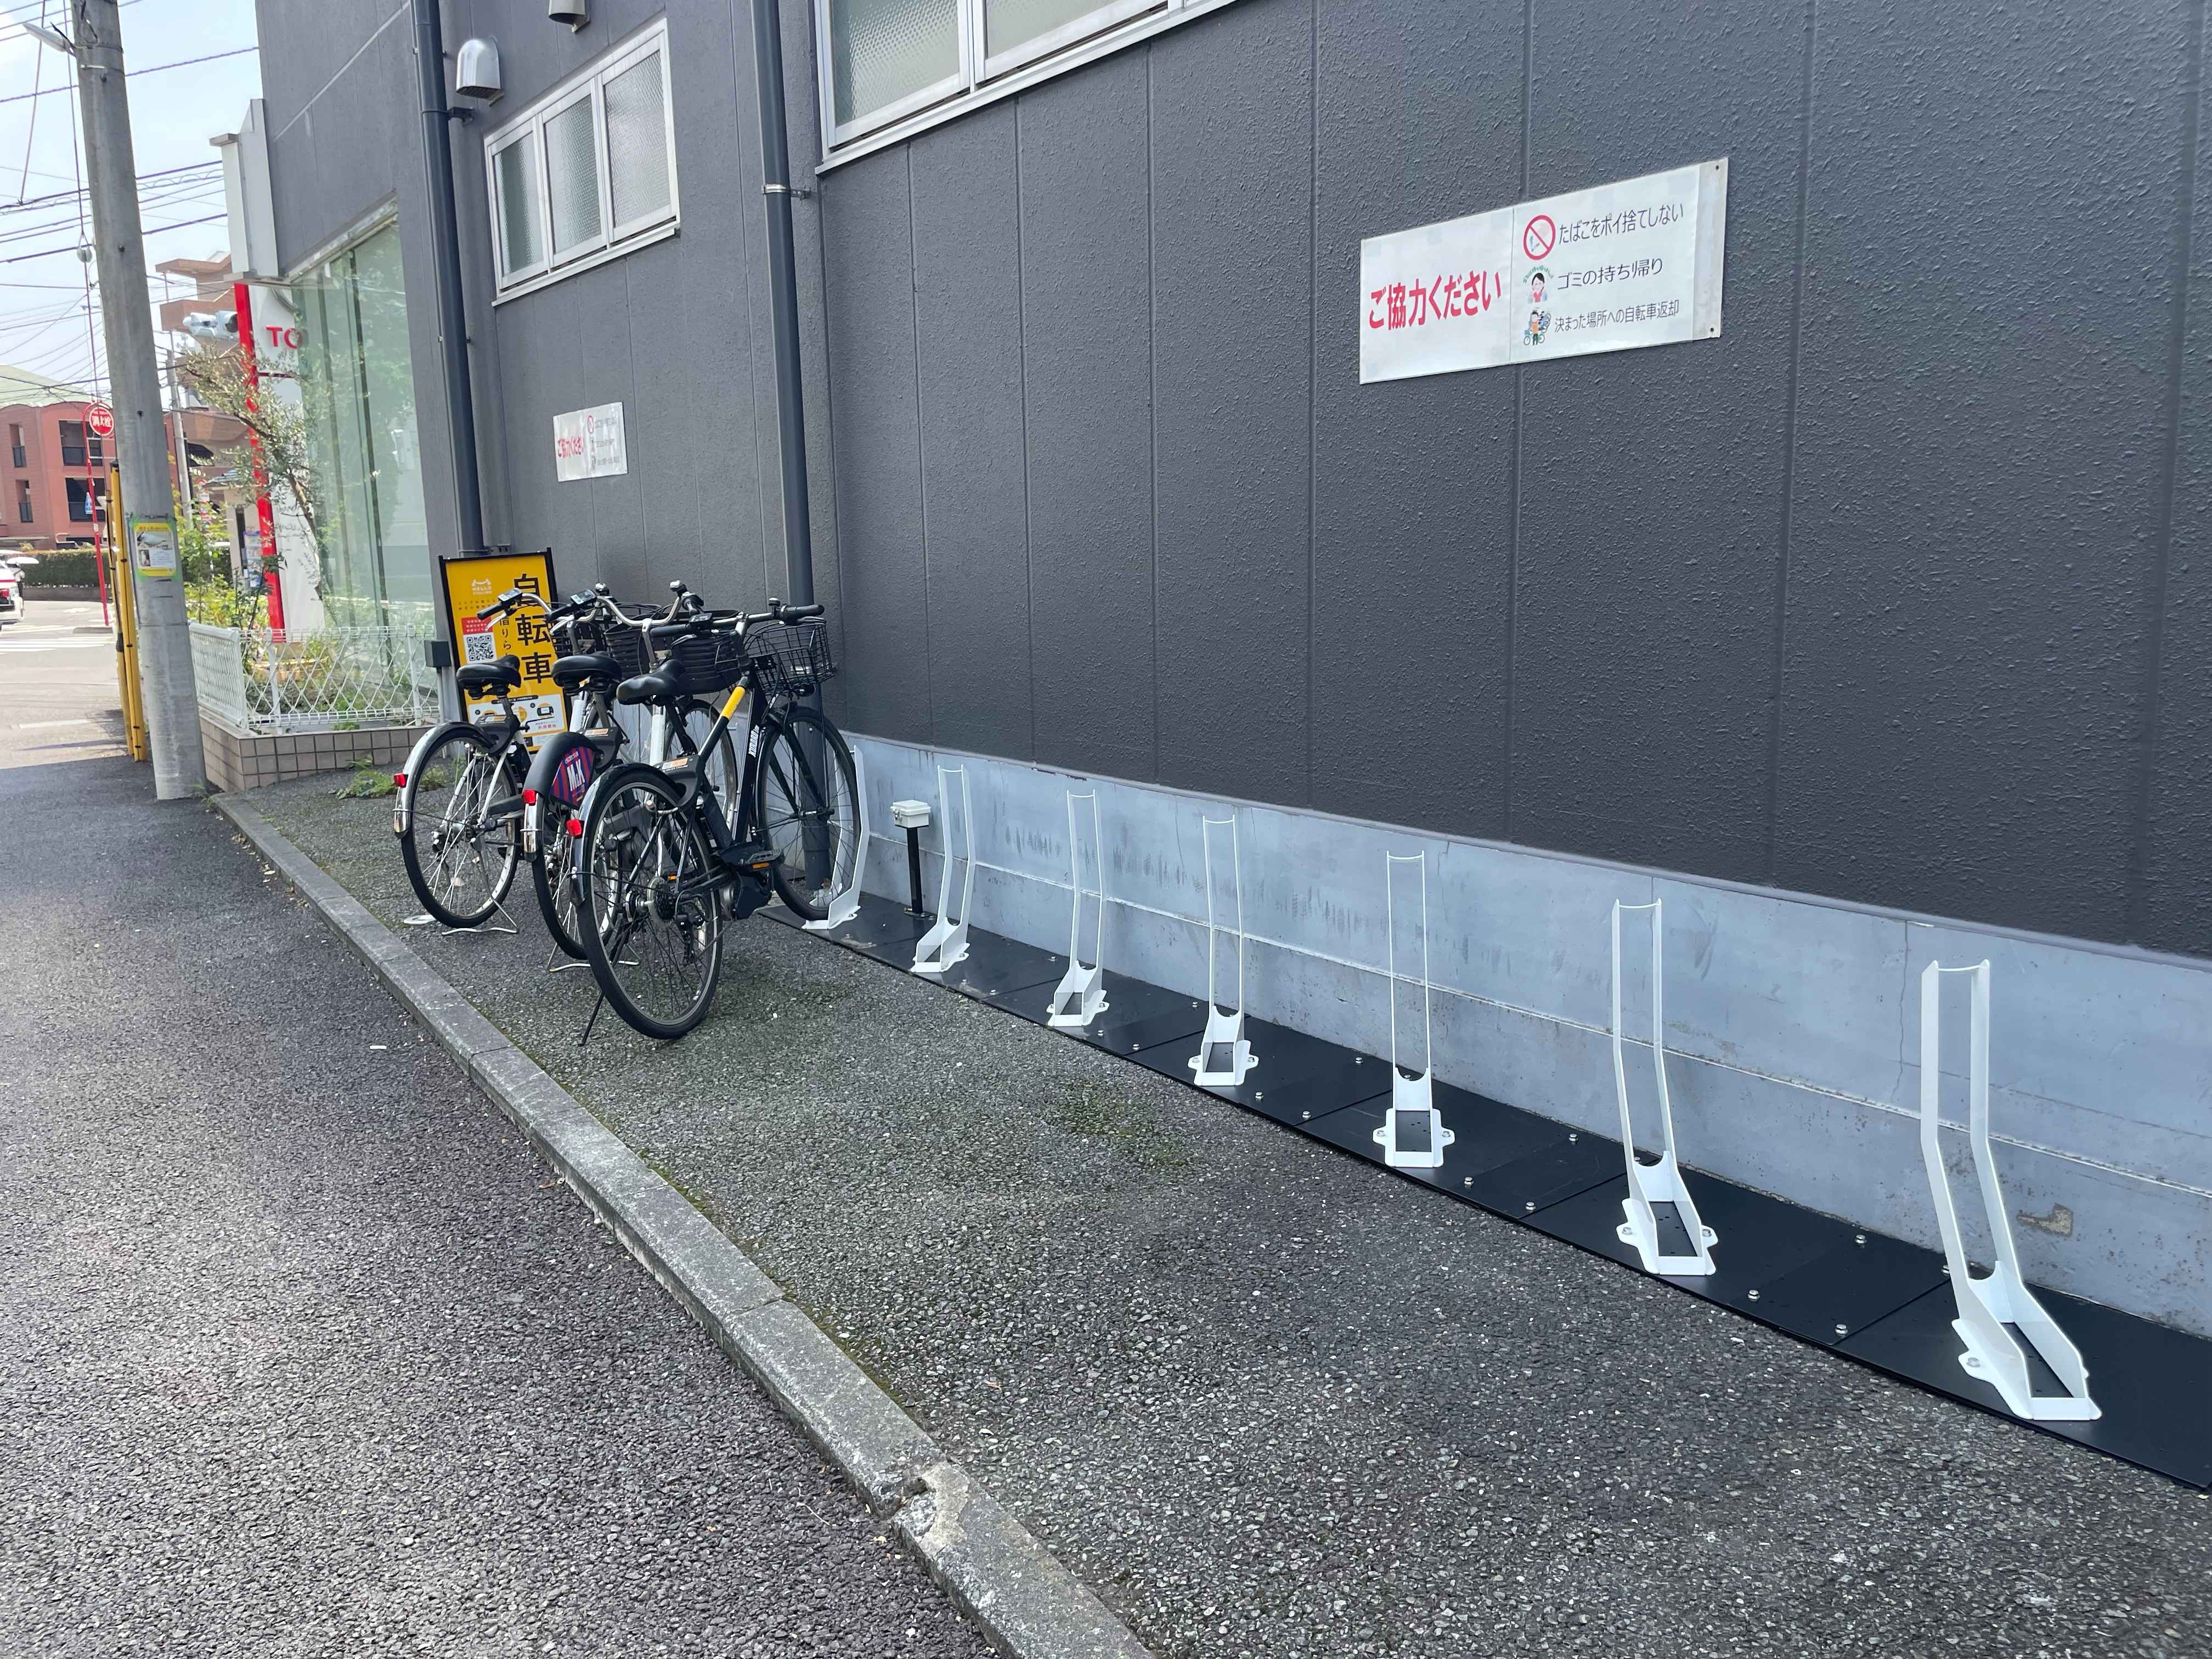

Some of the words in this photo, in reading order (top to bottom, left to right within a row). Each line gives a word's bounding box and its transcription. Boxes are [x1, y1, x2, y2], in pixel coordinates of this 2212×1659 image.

[1559, 203, 1683, 245] たばこをポイ捨てしない
[1557, 258, 1663, 290] ゴミの持ち帰り
[1369, 270, 1502, 330] ご協力ください
[1554, 298, 1680, 333] 決まった場所への自転車返却
[514, 573, 554, 684] 自転車
